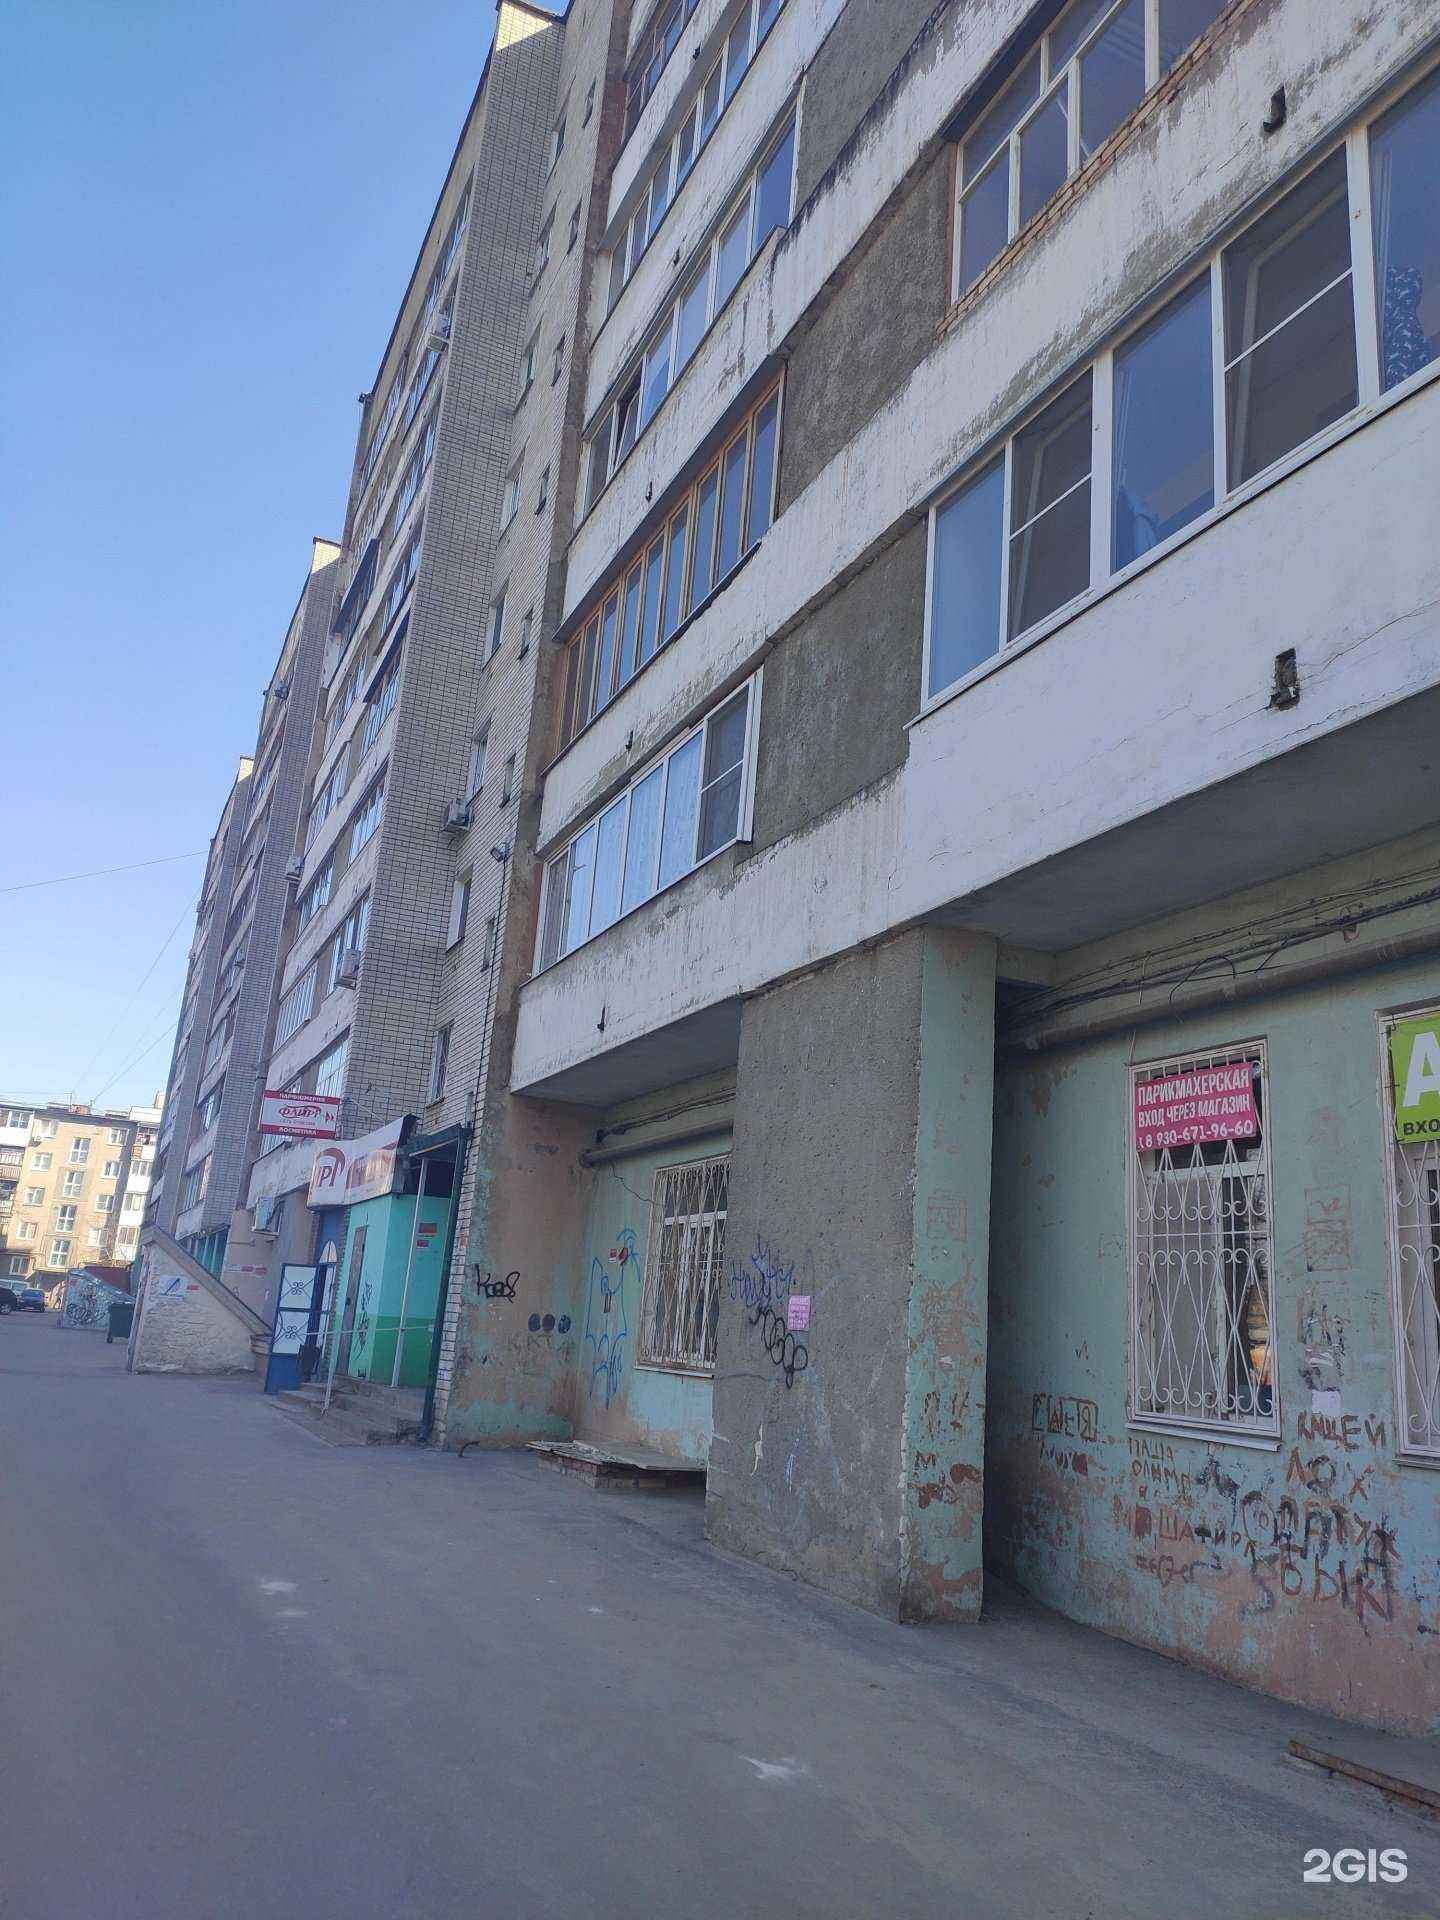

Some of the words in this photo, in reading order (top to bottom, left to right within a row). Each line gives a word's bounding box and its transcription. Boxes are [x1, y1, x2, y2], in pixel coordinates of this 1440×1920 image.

[1138, 1068, 1249, 1106] ПАРИКМАХЕРСКАЯ
[1138, 1108, 1165, 1128] ВХОД
[1167, 1102, 1196, 1123] ЧЕРЕЗ
[1198, 1094, 1251, 1117] МАГАЗИН
[1156, 1119, 1254, 1146] 930-671-96-60
